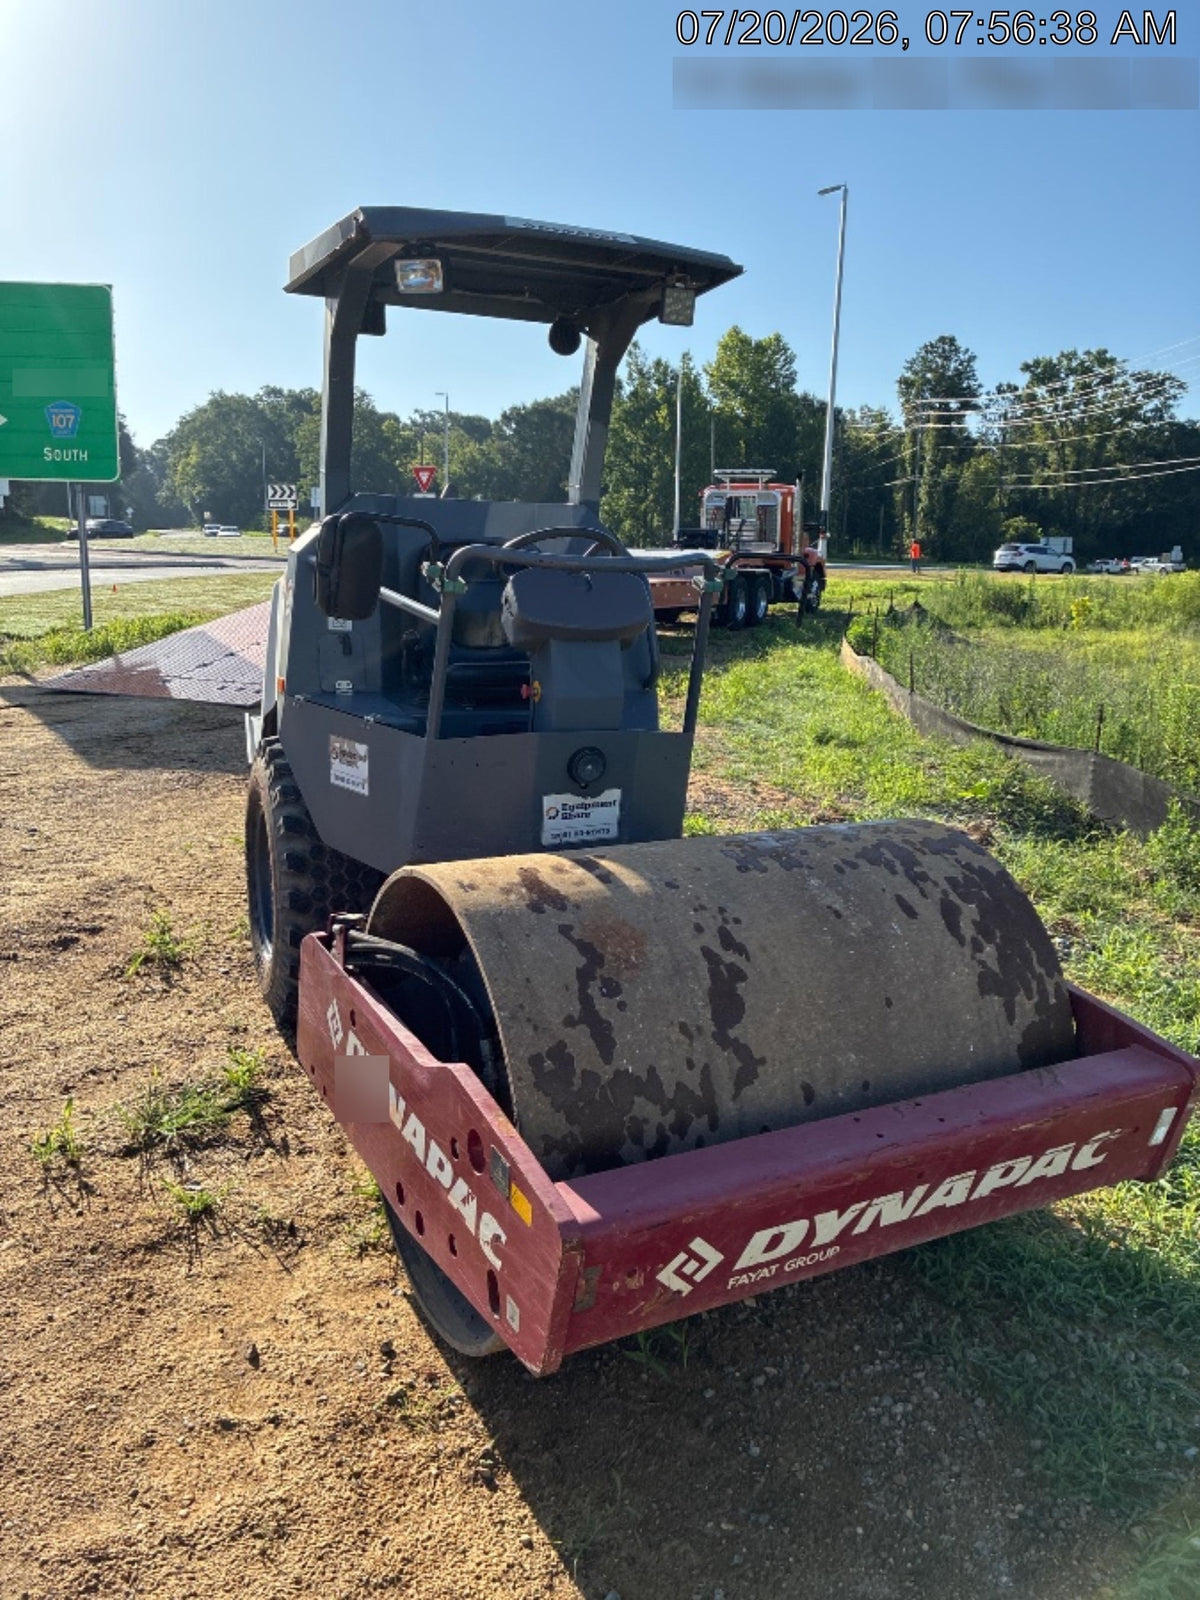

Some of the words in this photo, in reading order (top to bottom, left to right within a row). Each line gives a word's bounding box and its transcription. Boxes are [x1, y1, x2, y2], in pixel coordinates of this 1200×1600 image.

[52, 413, 75, 428] 107
[732, 1128, 1124, 1271] DYNAPAC
[727, 1263, 780, 1290] FAYAT
[784, 1246, 840, 1272] GROUP
